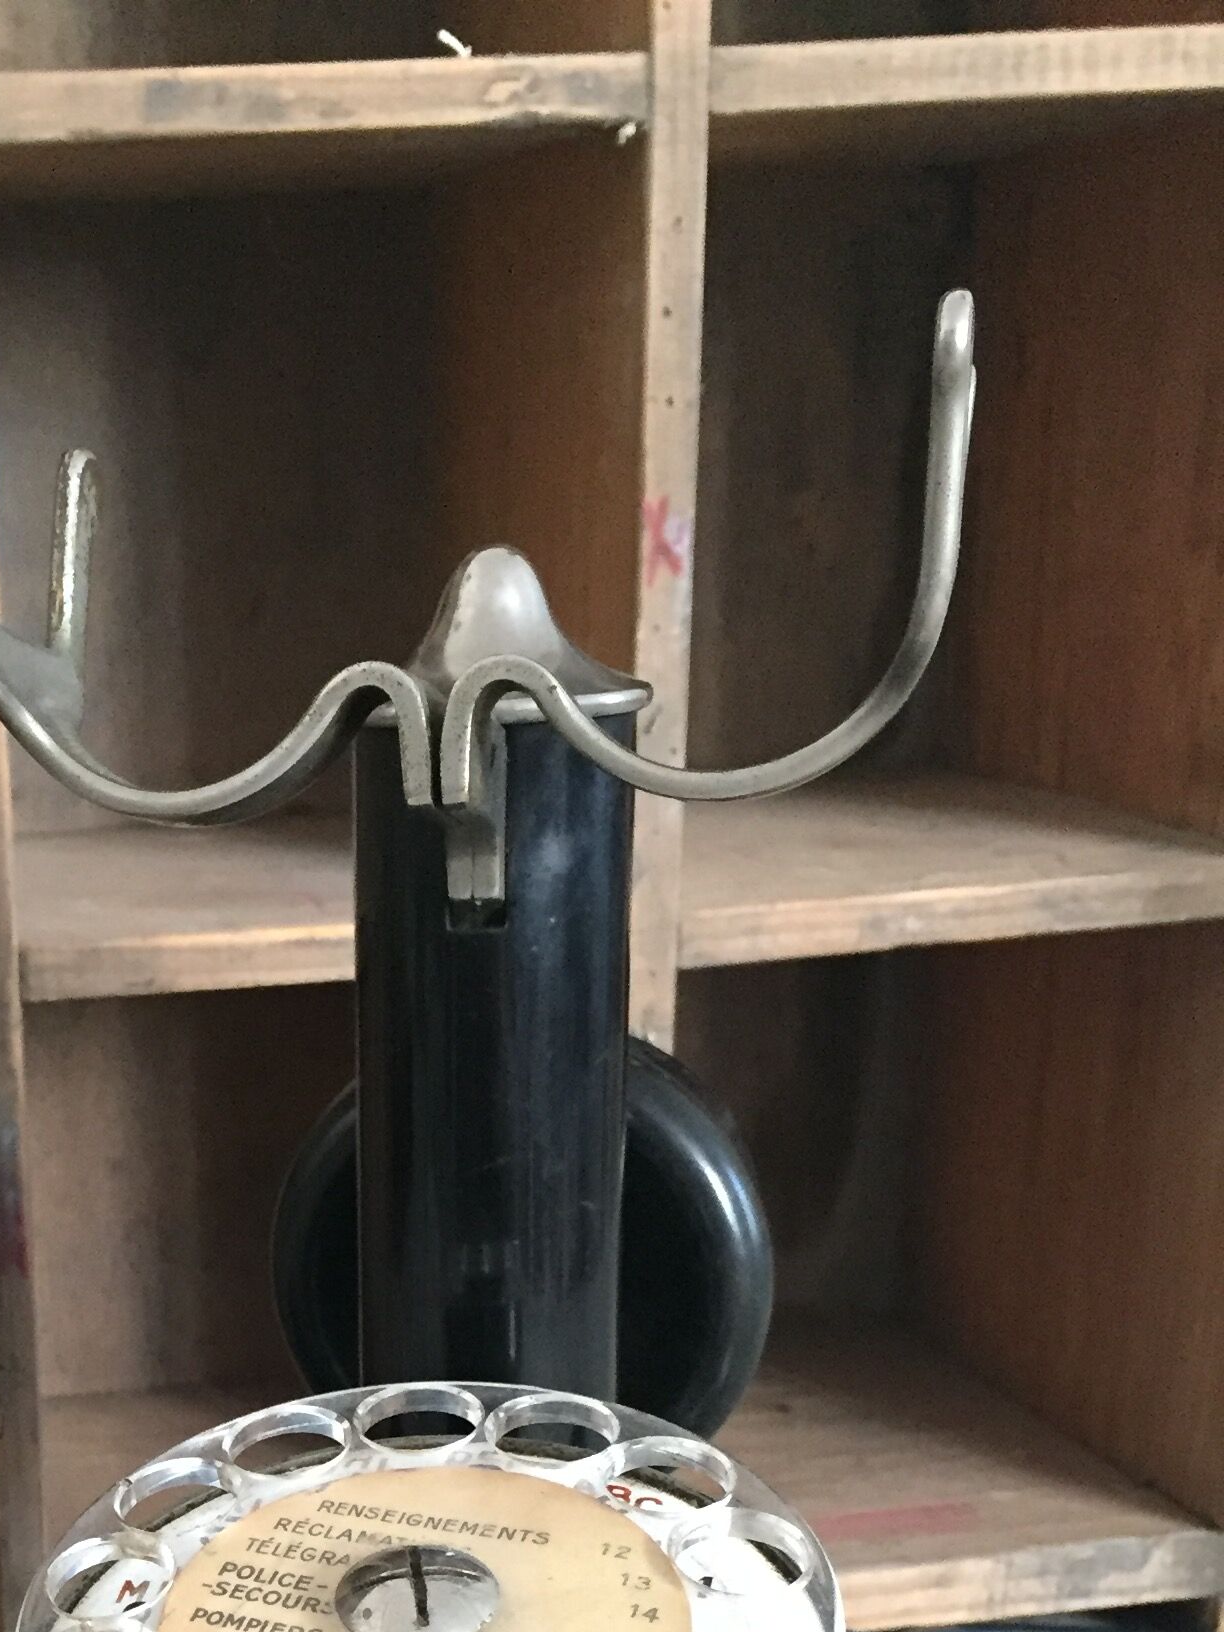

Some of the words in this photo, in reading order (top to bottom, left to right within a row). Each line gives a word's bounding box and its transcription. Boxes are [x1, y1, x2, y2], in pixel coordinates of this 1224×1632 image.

[317, 1499, 551, 1545] RENSEIGNEMENTS
[600, 1542, 632, 1560] 12
[621, 1572, 652, 1591] 13
[629, 1603, 660, 1624] 14
